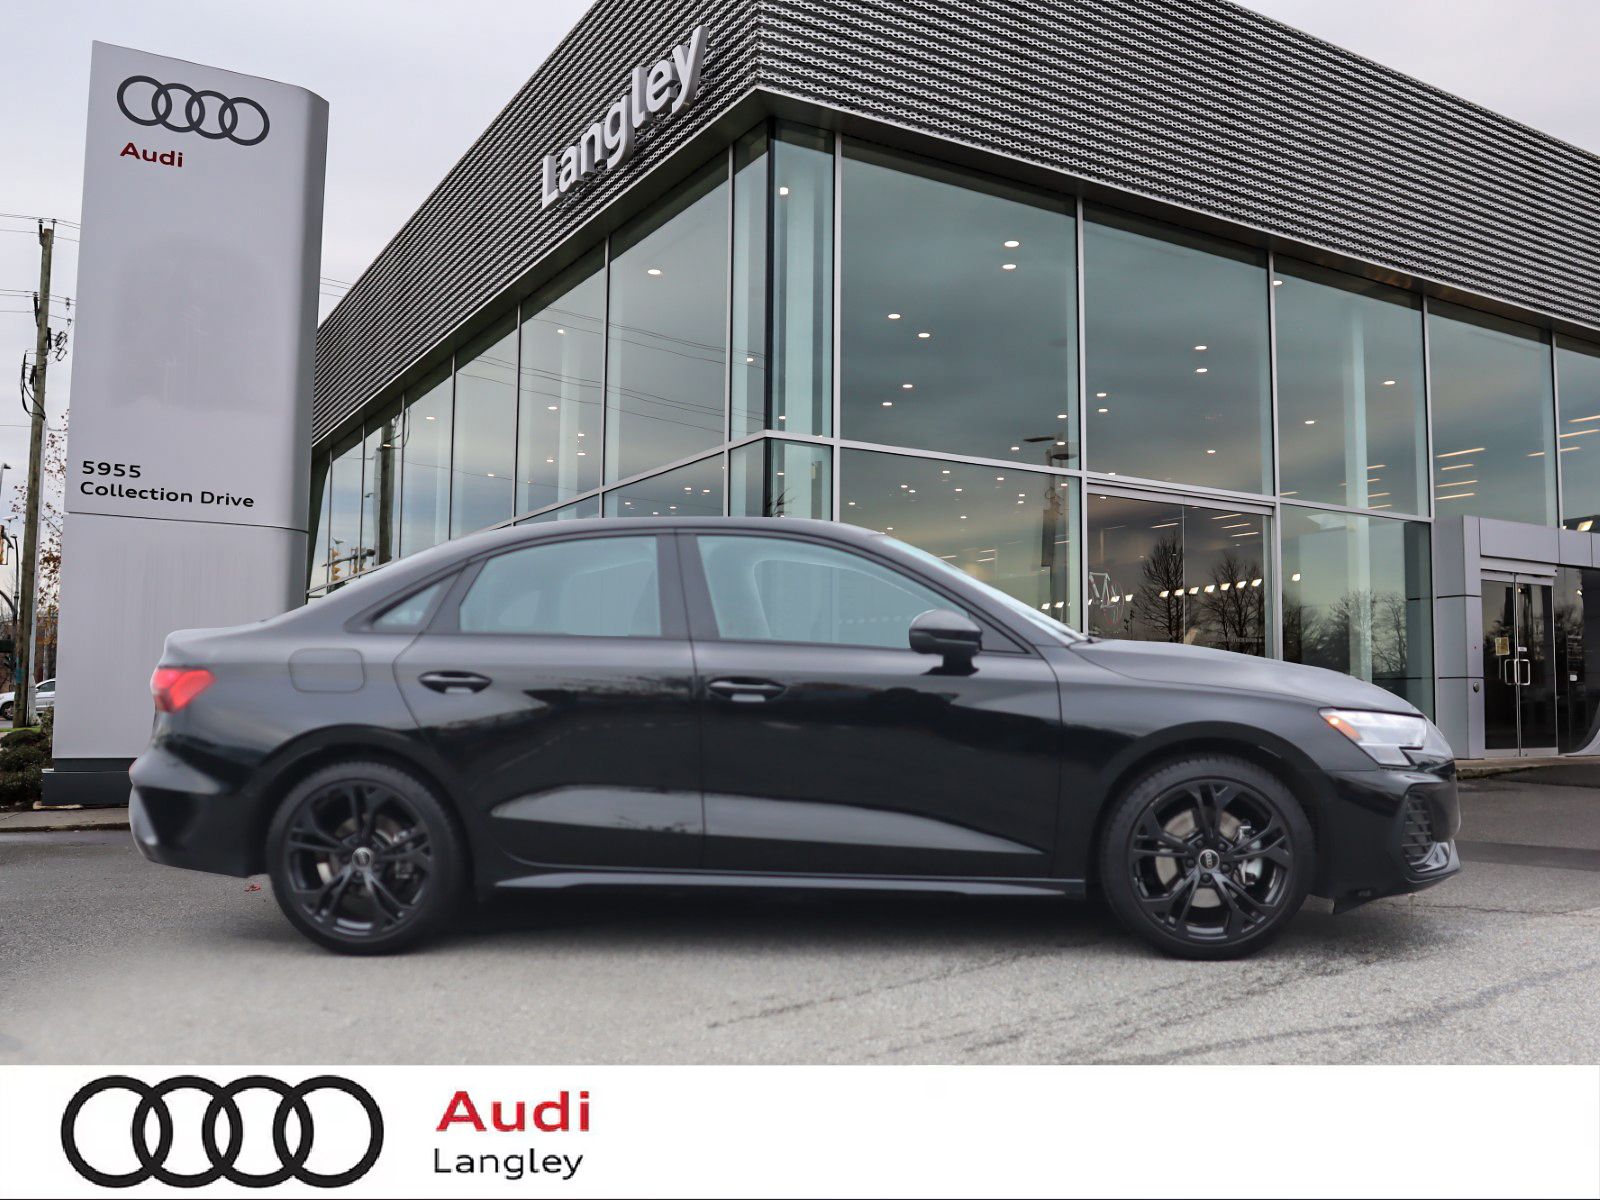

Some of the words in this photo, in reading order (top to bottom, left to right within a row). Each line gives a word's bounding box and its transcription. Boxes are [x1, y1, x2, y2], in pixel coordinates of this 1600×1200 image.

[541, 25, 710, 209] Langley
[120, 142, 184, 168] Audi
[82, 460, 142, 479] 5955
[80, 481, 193, 503] Collection
[200, 491, 255, 508] Drive
